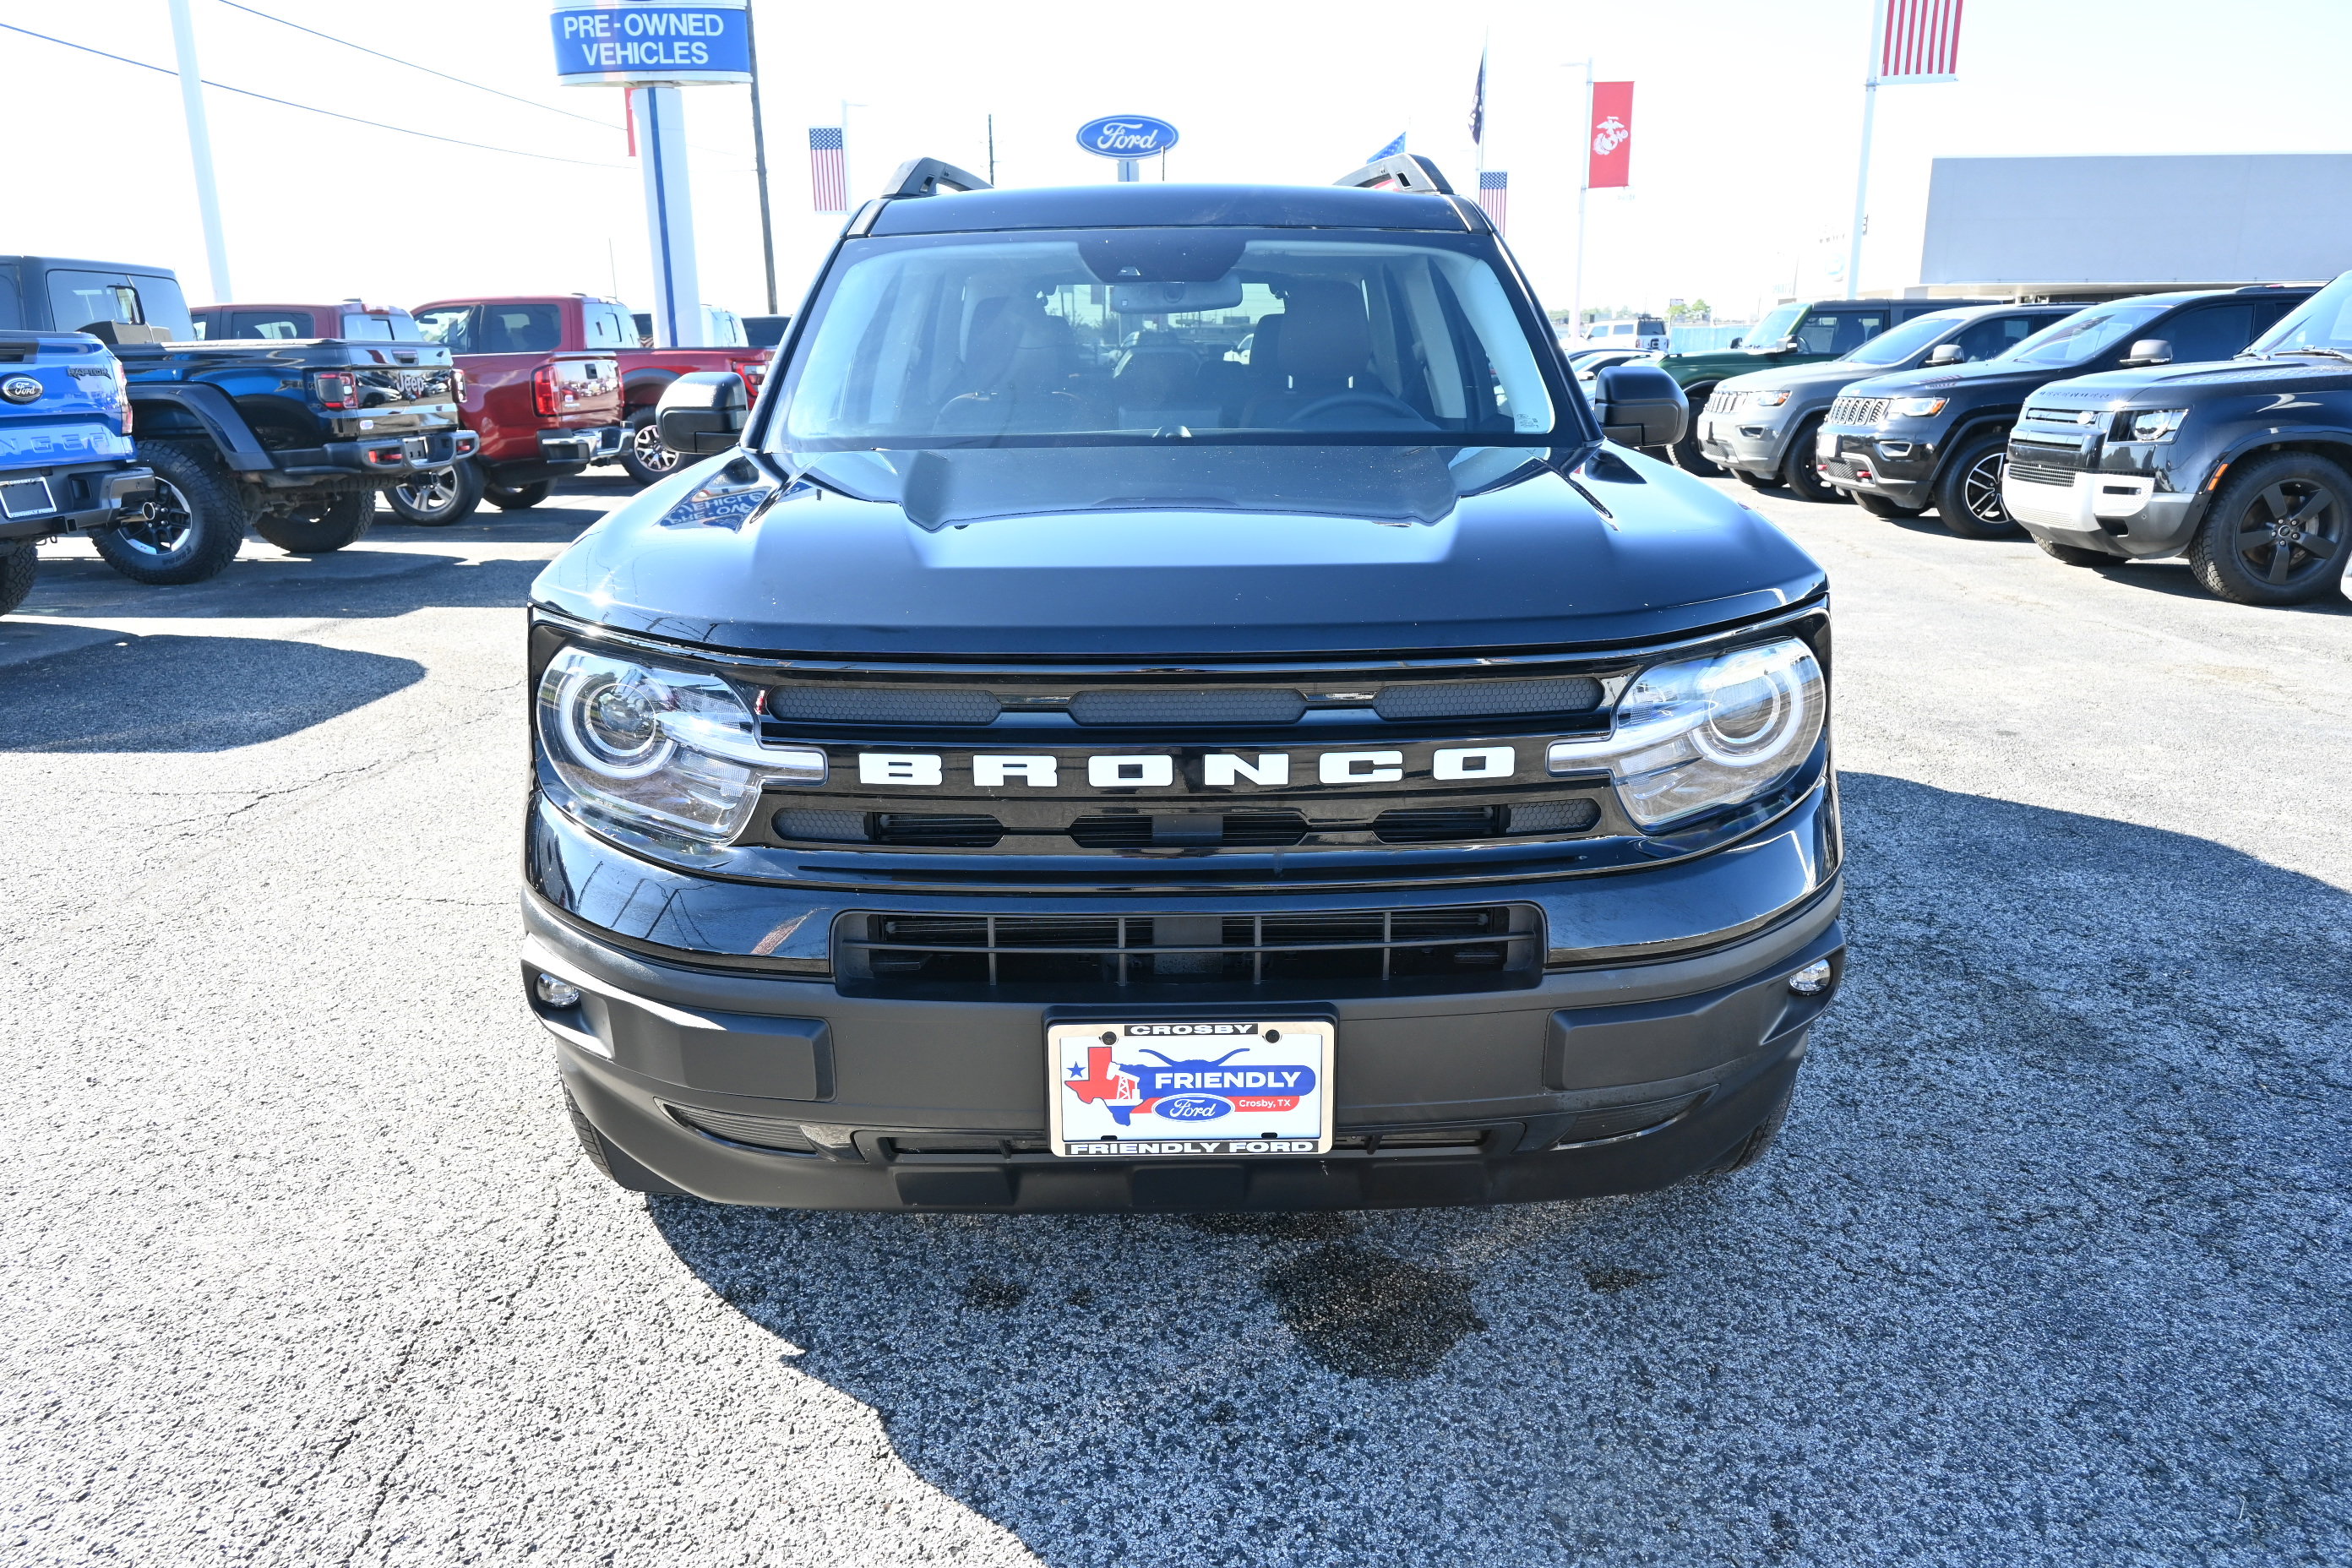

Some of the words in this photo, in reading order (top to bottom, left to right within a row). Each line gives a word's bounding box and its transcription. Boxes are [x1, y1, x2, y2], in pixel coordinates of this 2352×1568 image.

[564, 14, 724, 39] PRE-OWNED
[582, 41, 709, 66] VEHICLES
[1097, 122, 1158, 149] Ford
[66, 368, 112, 380] RAPTOR
[14, 382, 36, 395] Ford
[396, 372, 424, 395] Jeep
[858, 746, 1515, 787] BRONCO
[1130, 1025, 1254, 1036] CROSBY
[1155, 1071, 1302, 1089] FRIENDLY
[1170, 1098, 1217, 1117] Ford
[1239, 1099, 1276, 1108] Crosby,
[1070, 1141, 1225, 1155] FRIENDLY
[1228, 1141, 1315, 1153] FORD
